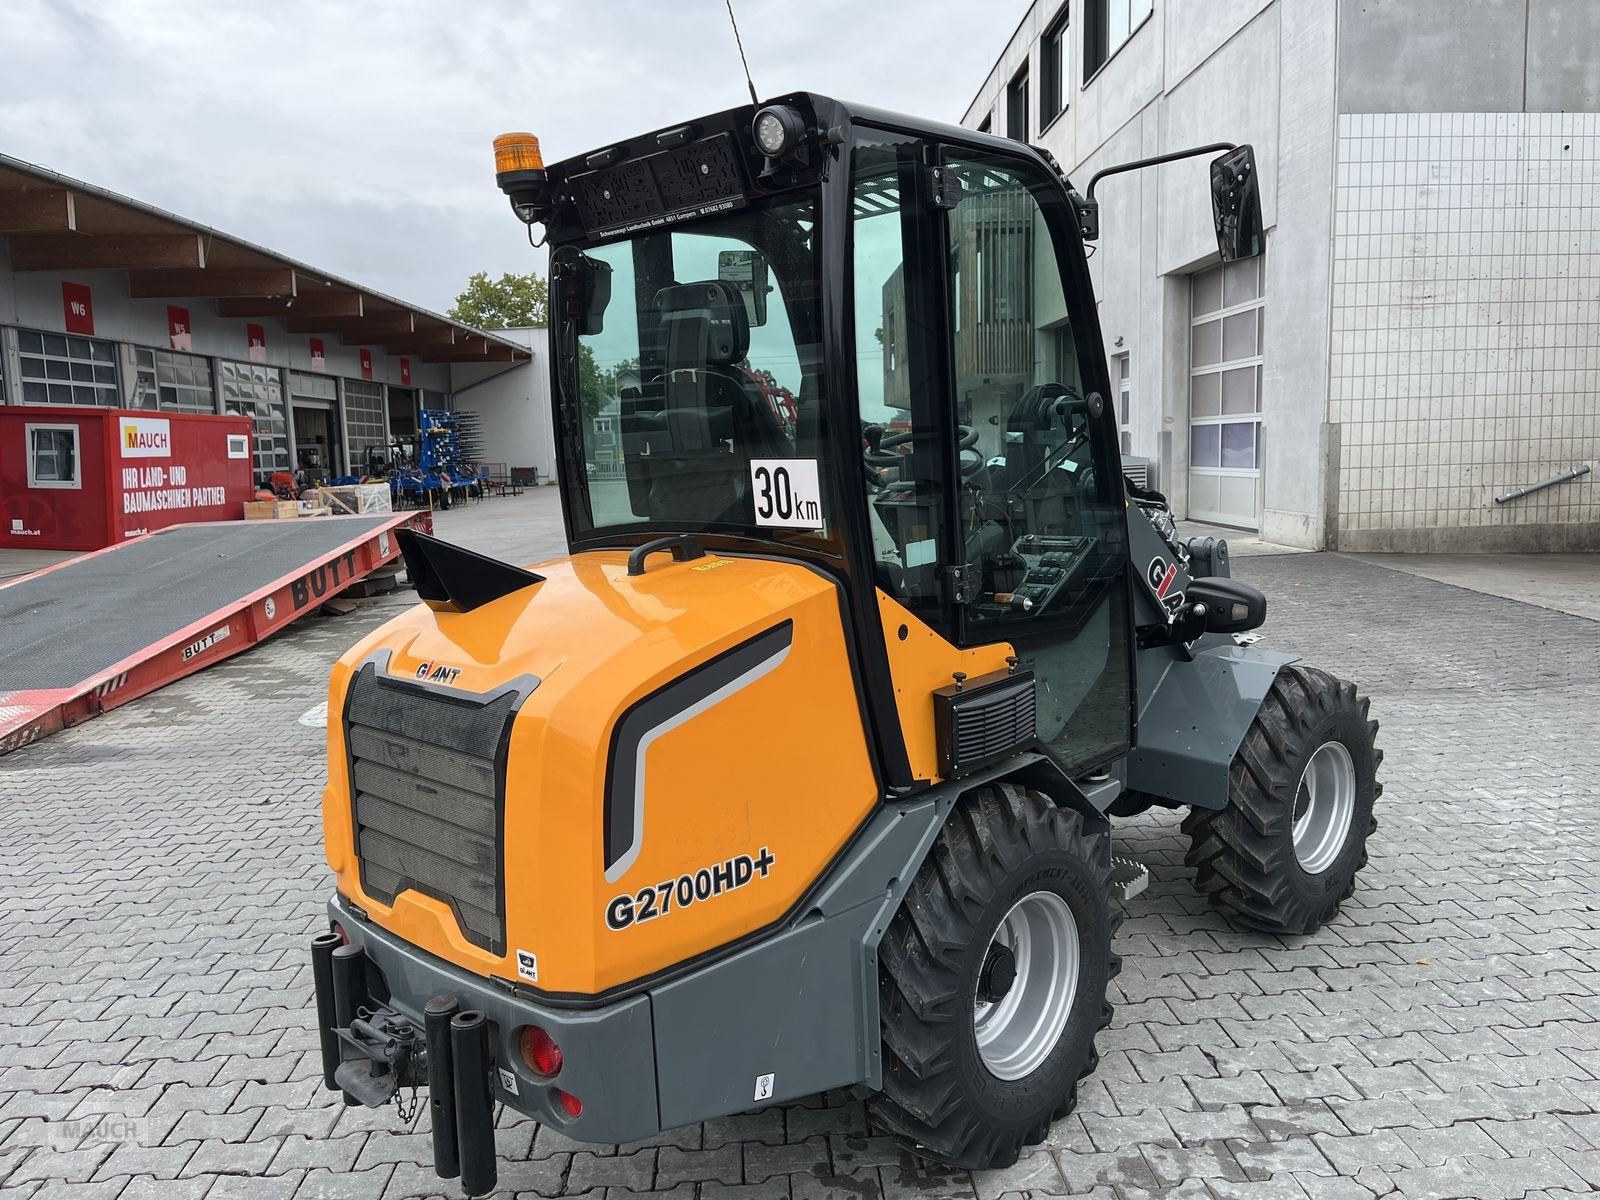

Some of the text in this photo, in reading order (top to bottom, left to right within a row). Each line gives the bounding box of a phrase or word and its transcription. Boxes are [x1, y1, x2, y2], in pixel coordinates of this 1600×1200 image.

[651, 218, 665, 226] GmbH
[70, 301, 86, 316] W6
[174, 322, 186, 334] W5
[128, 433, 167, 448] MAUCH
[122, 466, 186, 489] IHR LAND- UND
[124, 486, 226, 514] BAUMASCHINEN PARTNER
[755, 466, 819, 520] 30 km
[124, 527, 148, 537] mauch.at
[291, 549, 358, 611] BUTT
[184, 633, 216, 659] BUTT
[605, 846, 775, 931] G2700HD+
